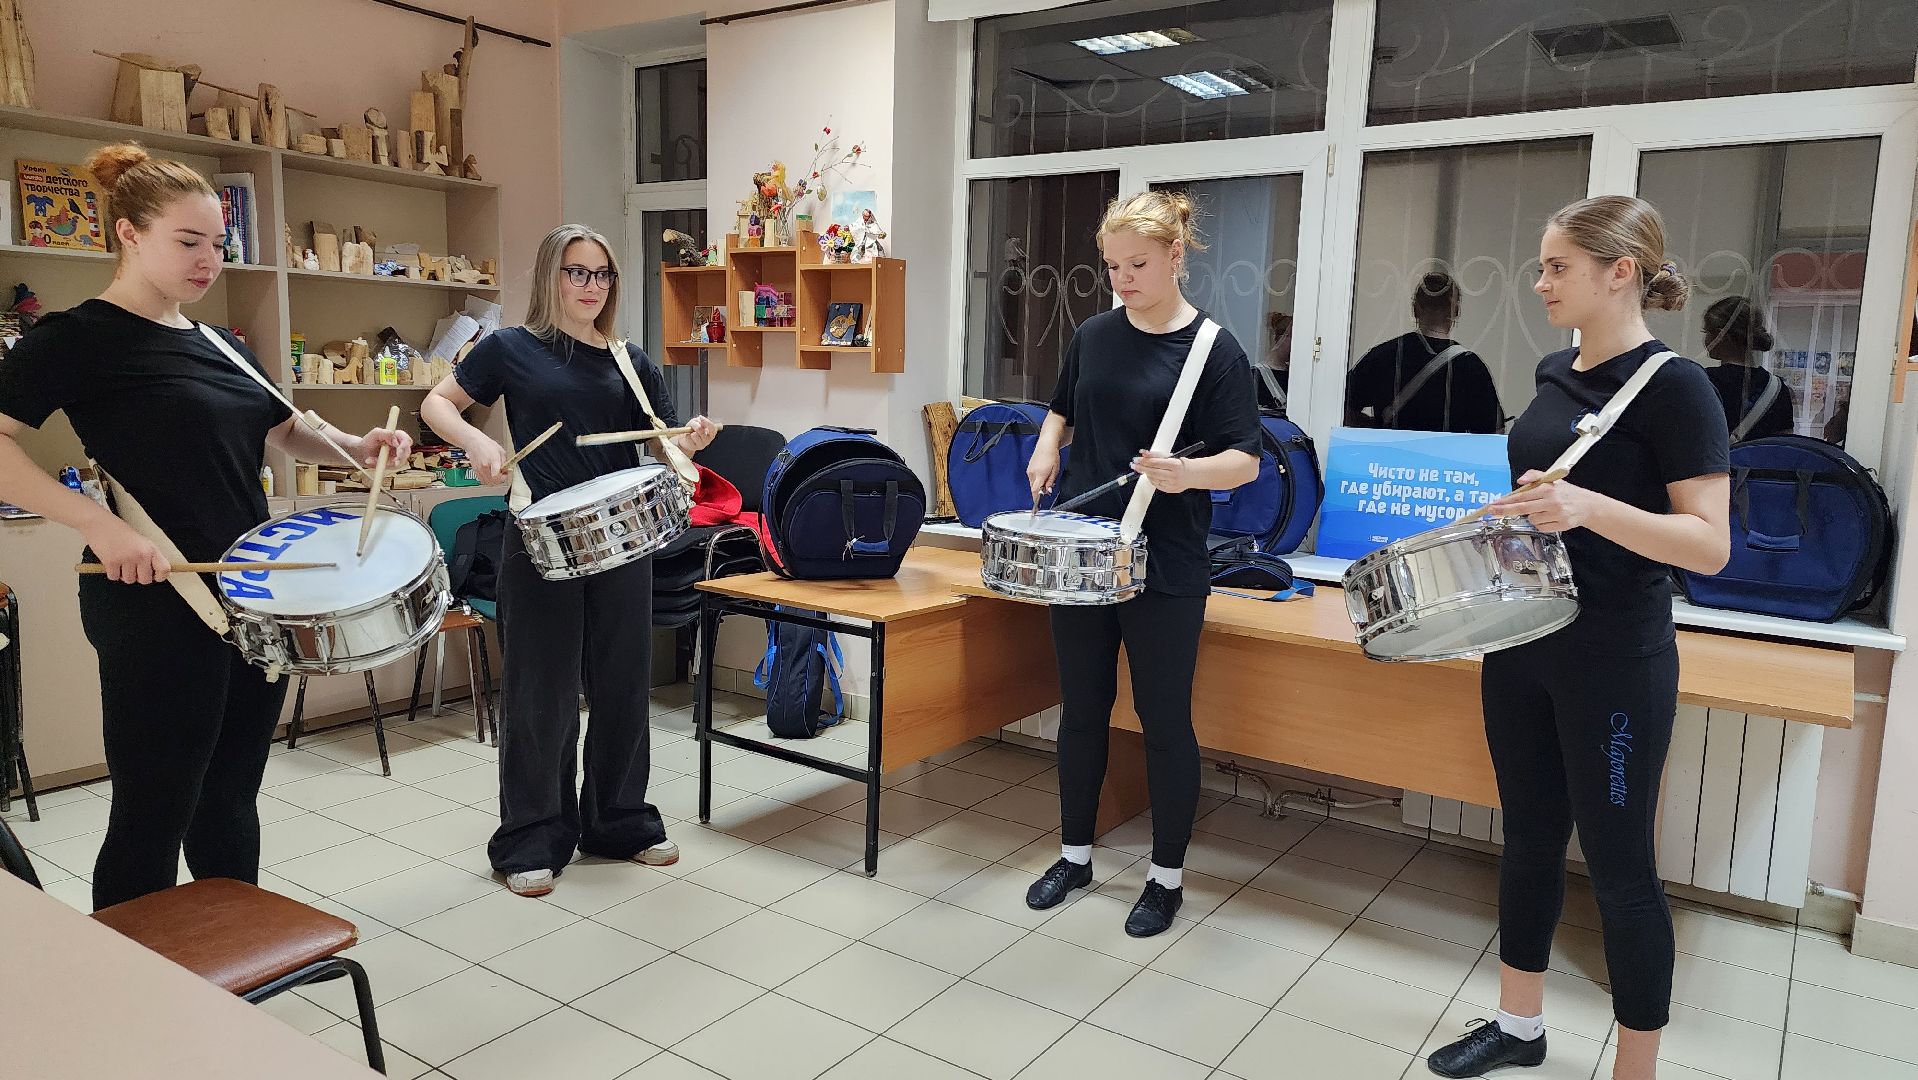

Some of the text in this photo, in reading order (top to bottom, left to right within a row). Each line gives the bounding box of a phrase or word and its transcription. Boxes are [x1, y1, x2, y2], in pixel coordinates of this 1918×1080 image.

[25, 183, 80, 197] творчества
[45, 176, 88, 187] детского
[1368, 462, 1480, 486] Чисто не там,
[1340, 480, 1368, 495] где
[1372, 481, 1450, 503] убирают,
[1454, 489, 1464, 501] а
[1358, 499, 1386, 514] где
[1390, 502, 1410, 516] не
[1600, 712, 1633, 807] Majorettes
